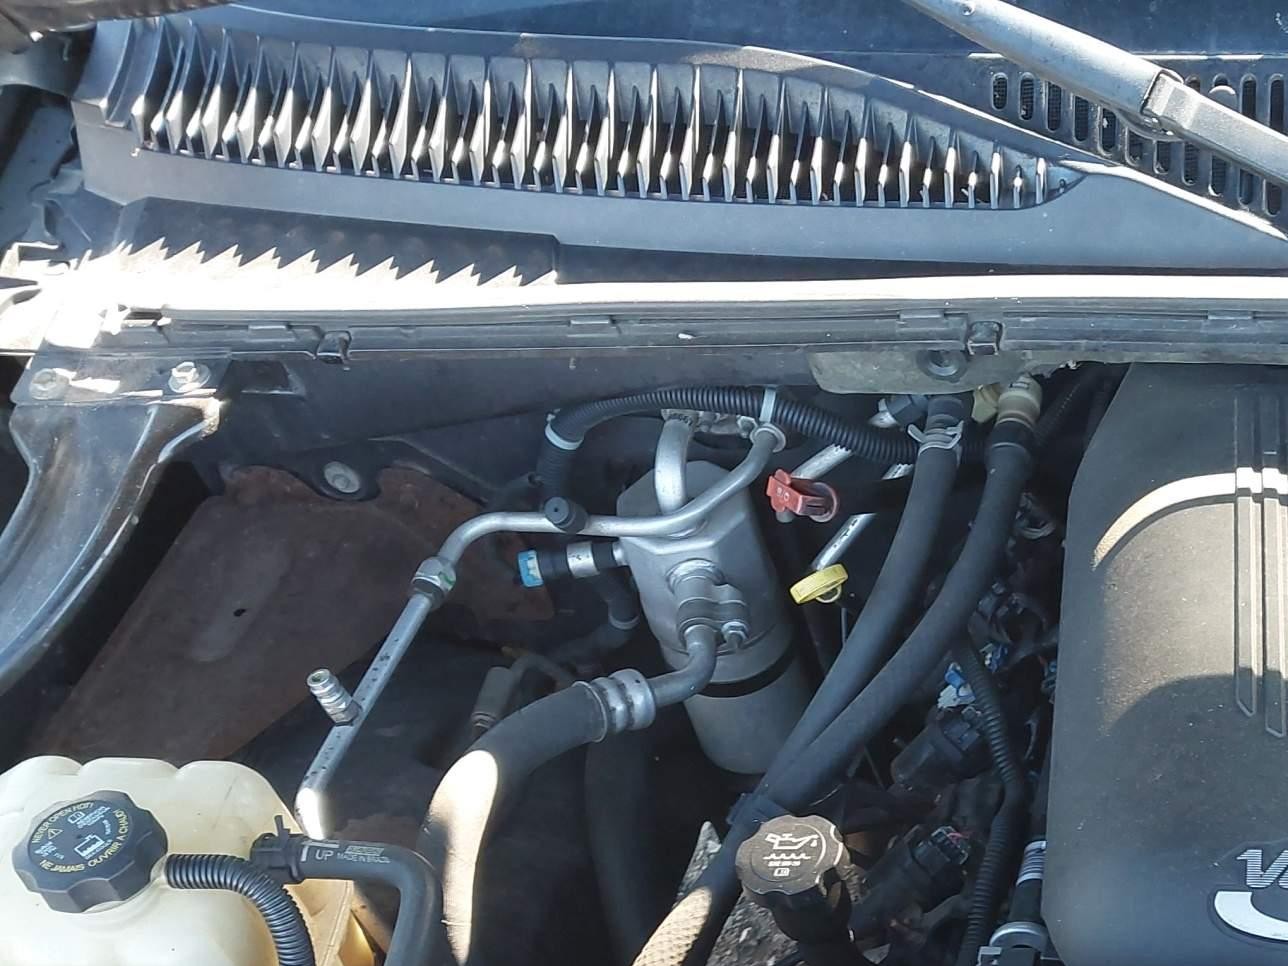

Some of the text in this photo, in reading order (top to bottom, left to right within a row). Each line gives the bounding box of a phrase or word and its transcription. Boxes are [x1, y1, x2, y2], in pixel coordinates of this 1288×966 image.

[32, 824, 49, 843] NEVER
[49, 808, 72, 822] OPEN
[87, 842, 122, 867] OUVRIR
[316, 849, 334, 860] UP
